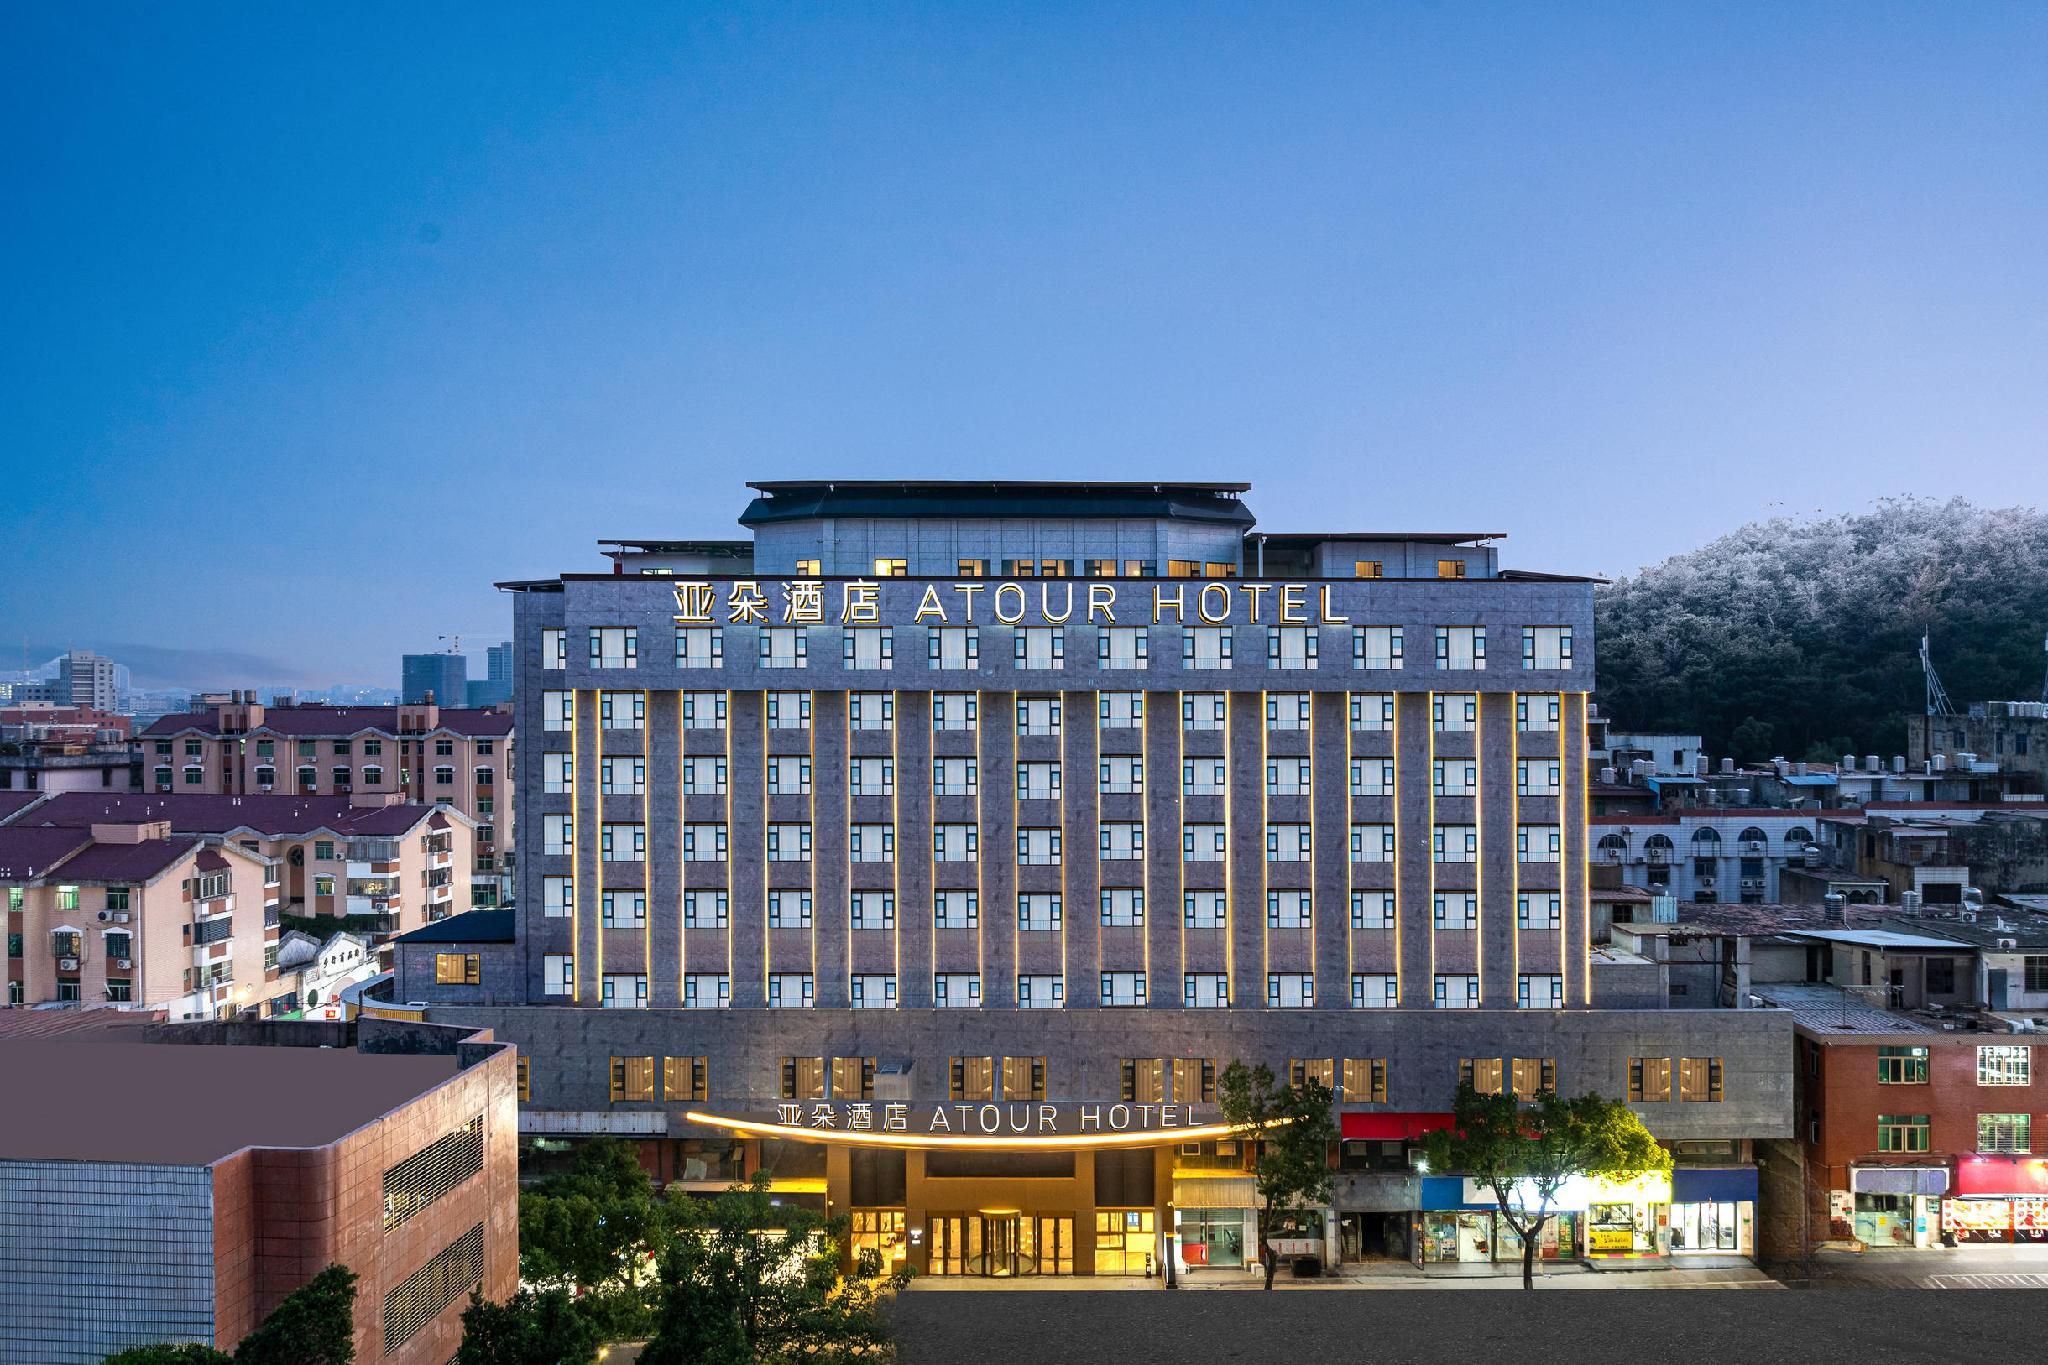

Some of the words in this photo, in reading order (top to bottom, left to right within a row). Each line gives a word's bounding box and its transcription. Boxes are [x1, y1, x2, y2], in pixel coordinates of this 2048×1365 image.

[672, 579, 880, 624] 亚朵酒店
[914, 582, 1117, 624] ATOUR
[1152, 582, 1350, 624] HOTEL
[777, 1102, 908, 1132] 亚朵酒店
[929, 1104, 1057, 1133] ATOUR
[1080, 1104, 1203, 1132] HOTEL
